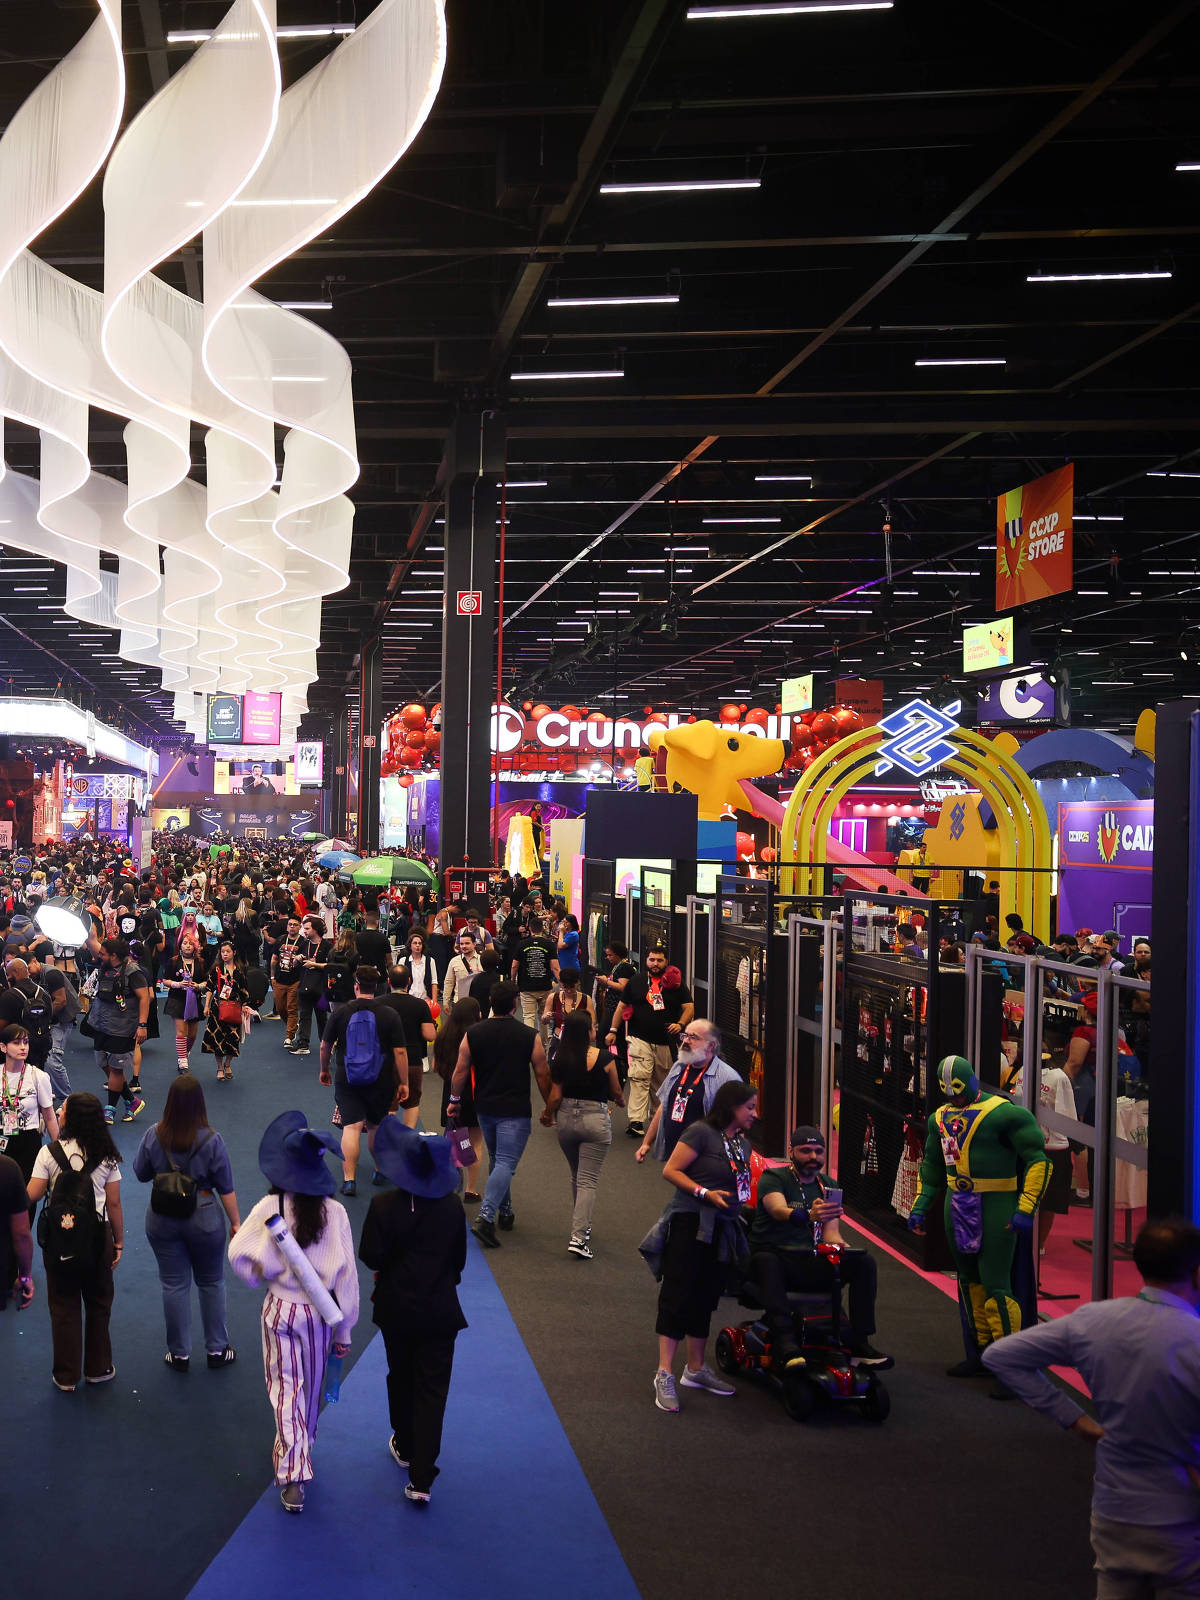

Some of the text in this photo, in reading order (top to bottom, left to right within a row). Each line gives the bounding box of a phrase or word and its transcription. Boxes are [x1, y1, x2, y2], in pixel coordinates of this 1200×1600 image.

[1029, 512, 1059, 540] CCXP
[1027, 531, 1065, 561] STORE
[537, 712, 791, 748] Cruncoll
[476, 882, 485, 892] H
